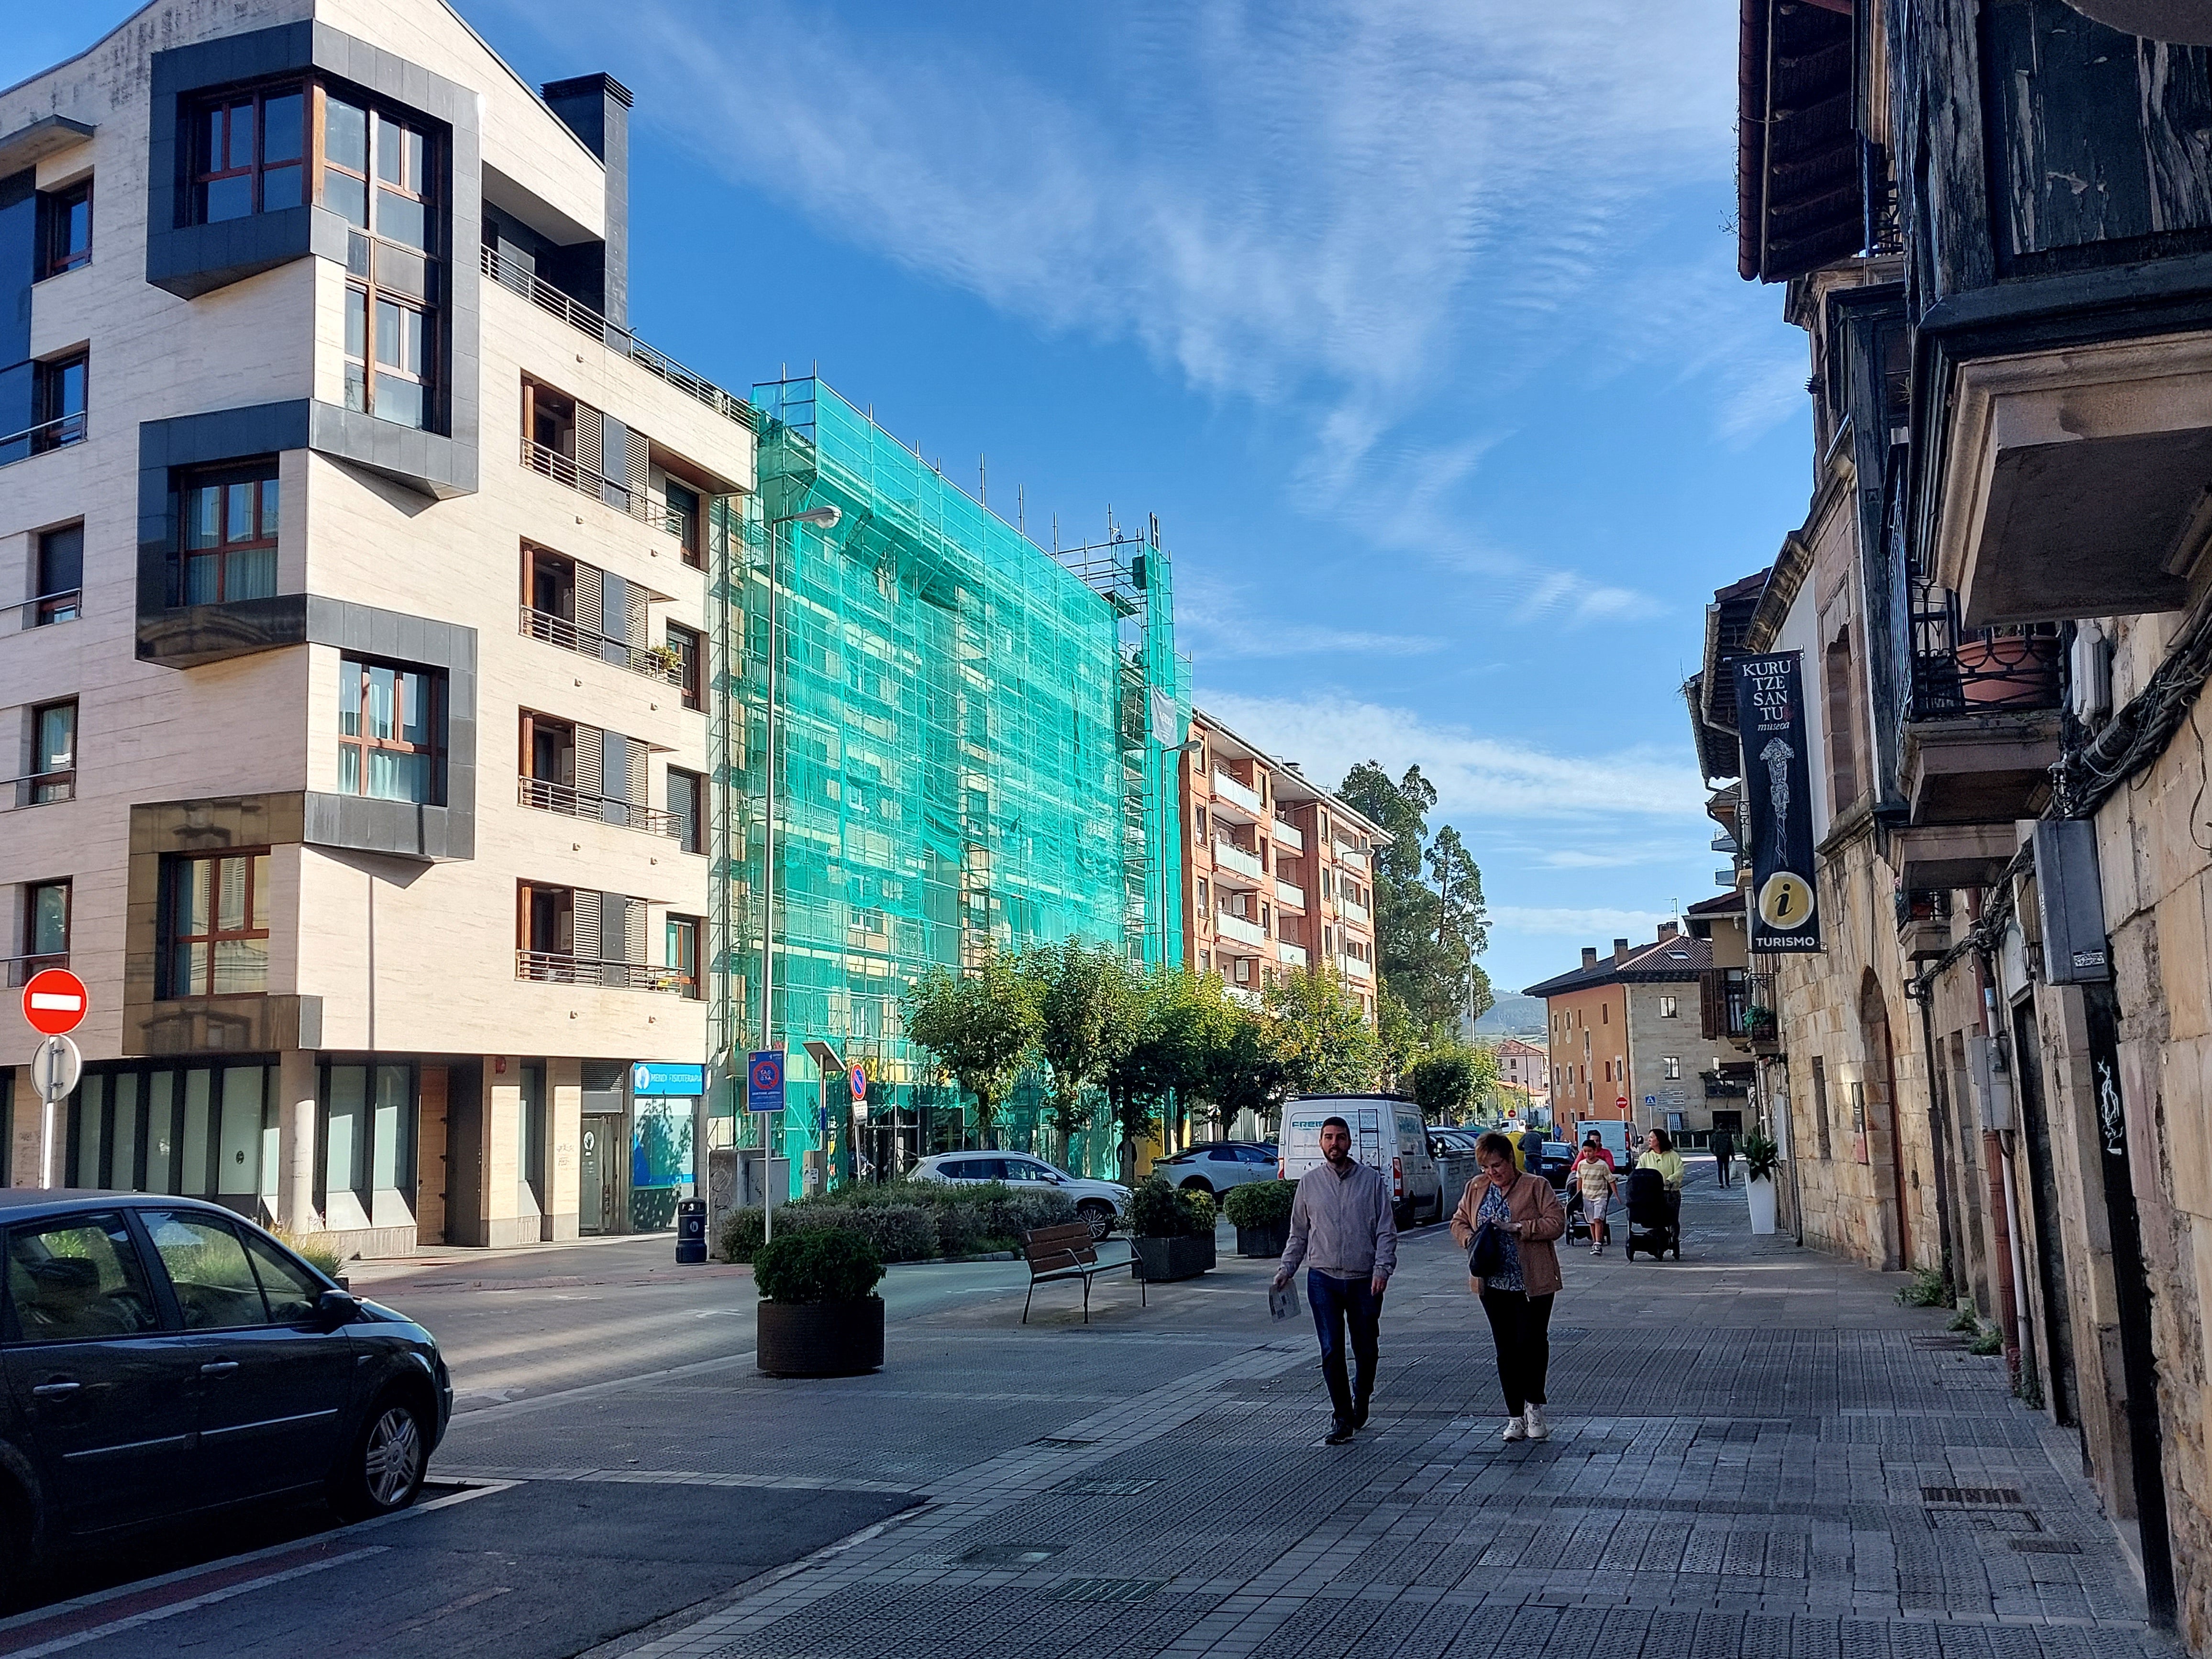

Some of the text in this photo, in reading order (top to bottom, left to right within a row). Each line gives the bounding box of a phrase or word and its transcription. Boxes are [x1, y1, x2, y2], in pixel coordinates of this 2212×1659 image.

[1742, 660, 1792, 676] KURU
[1752, 676, 1785, 691] TZE
[1753, 690, 1788, 706] SAN
[1760, 706, 1784, 721] TU
[1758, 722, 1790, 731] museoa
[1756, 937, 1815, 947] TURISMO
